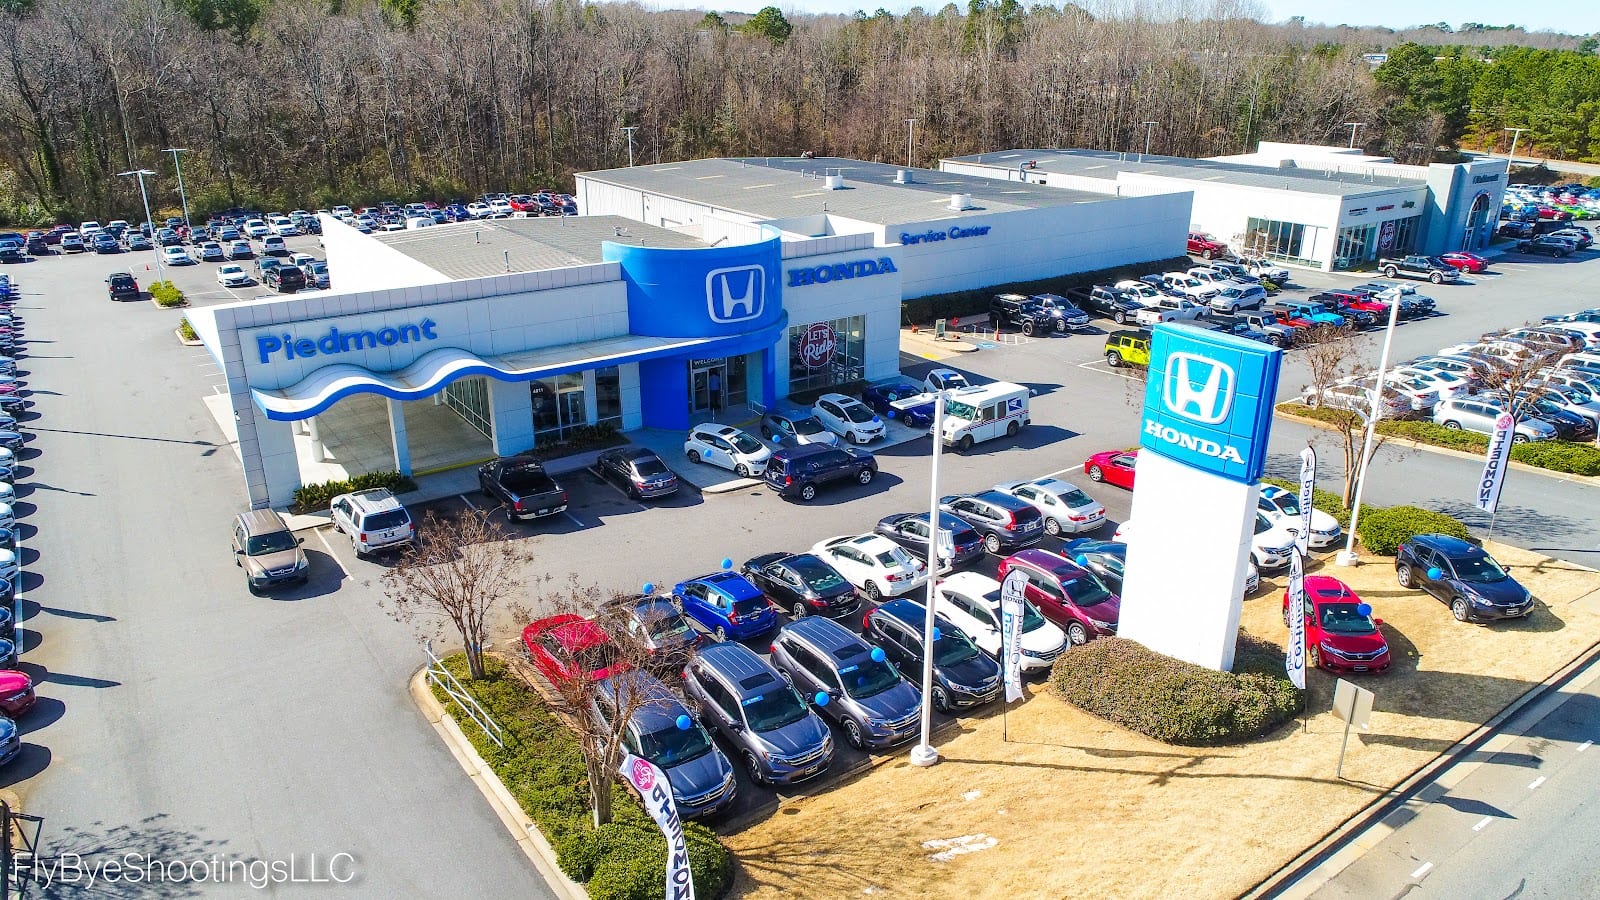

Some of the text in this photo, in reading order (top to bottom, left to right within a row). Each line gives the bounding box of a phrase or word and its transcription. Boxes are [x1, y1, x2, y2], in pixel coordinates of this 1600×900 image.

[900, 226, 991, 245] Service Center
[788, 257, 898, 287] HONDA
[256, 317, 437, 364] Piedmont
[809, 329, 828, 341] LET'S
[804, 339, 834, 362] Ride
[1144, 419, 1245, 464] HONDA
